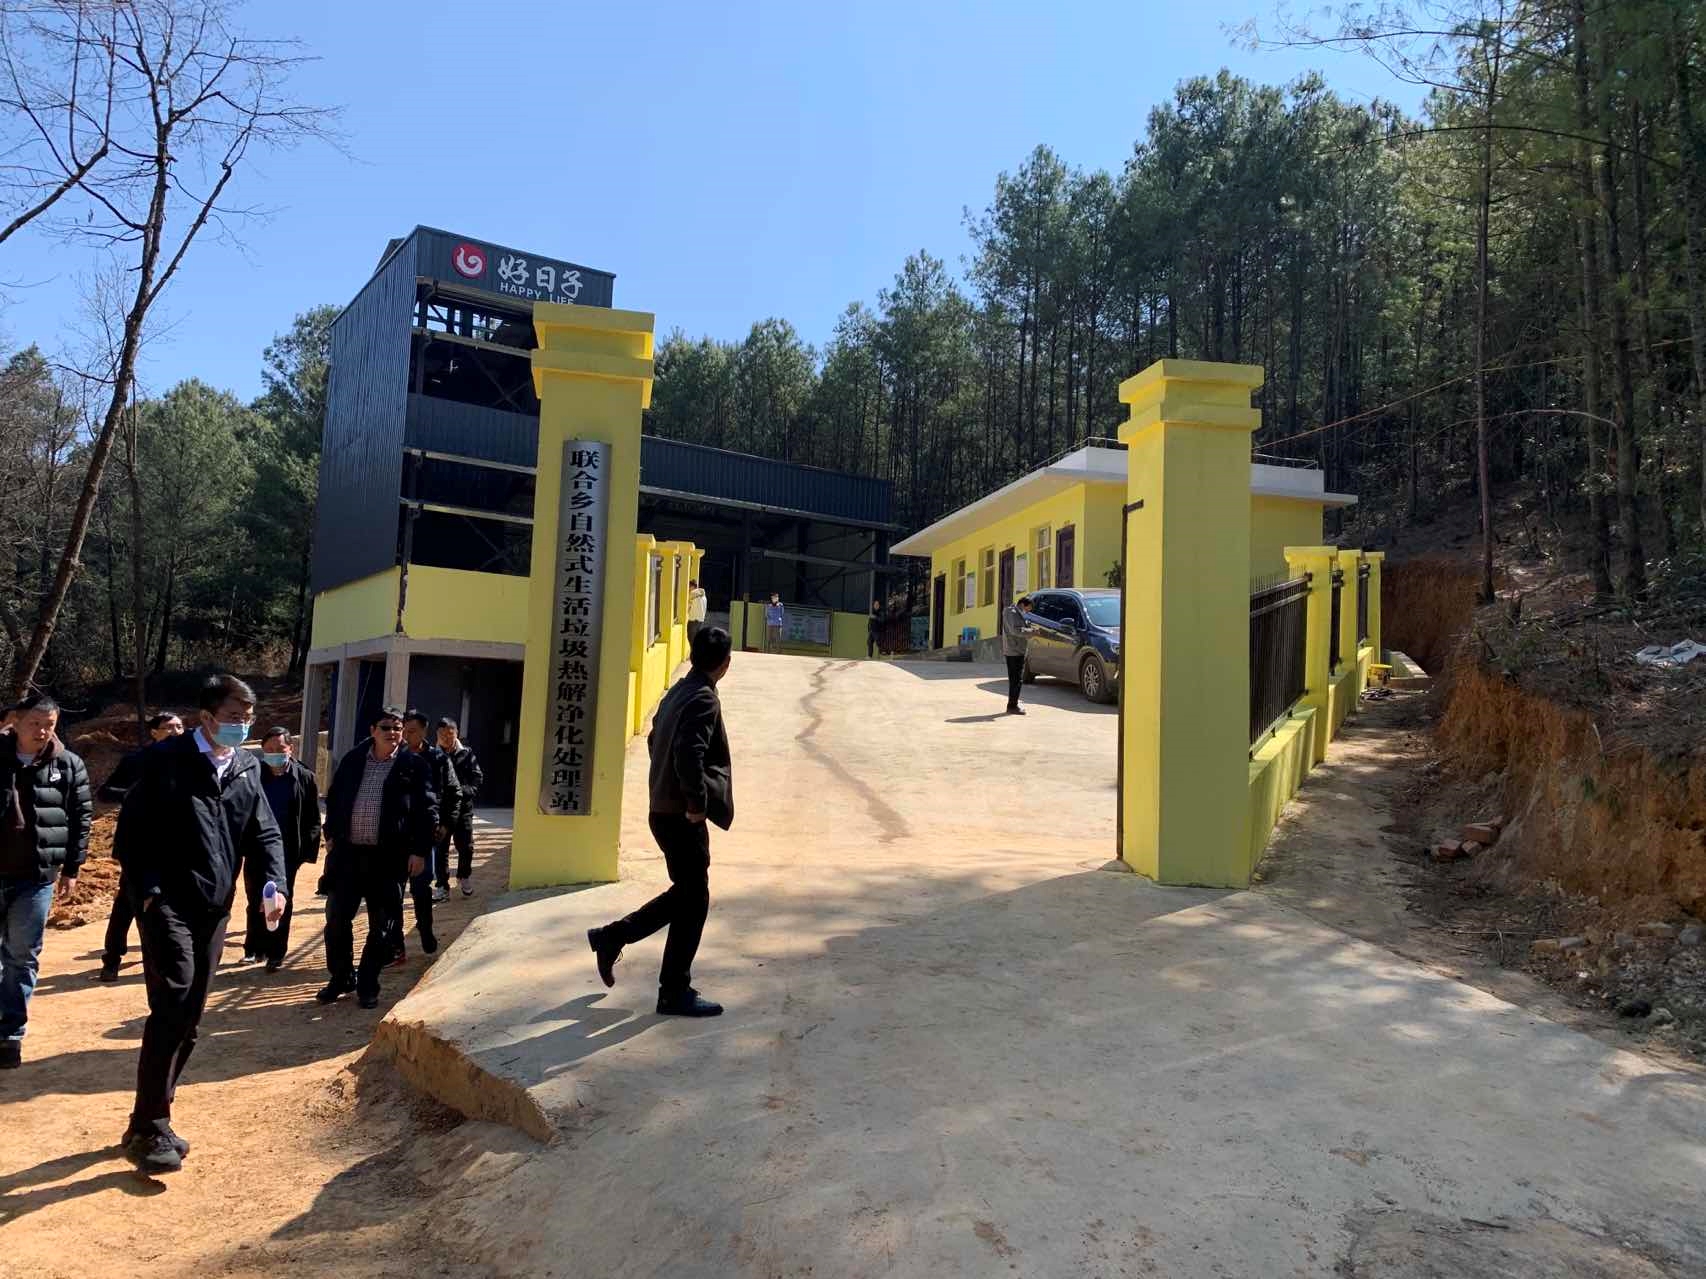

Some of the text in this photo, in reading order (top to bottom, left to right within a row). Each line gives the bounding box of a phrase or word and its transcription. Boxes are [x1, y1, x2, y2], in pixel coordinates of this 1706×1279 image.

[498, 254, 584, 299] 好日子
[500, 282, 542, 300] HAPPY
[549, 449, 600, 811] 联合乡自然式生活垃圾热解净化处理站
